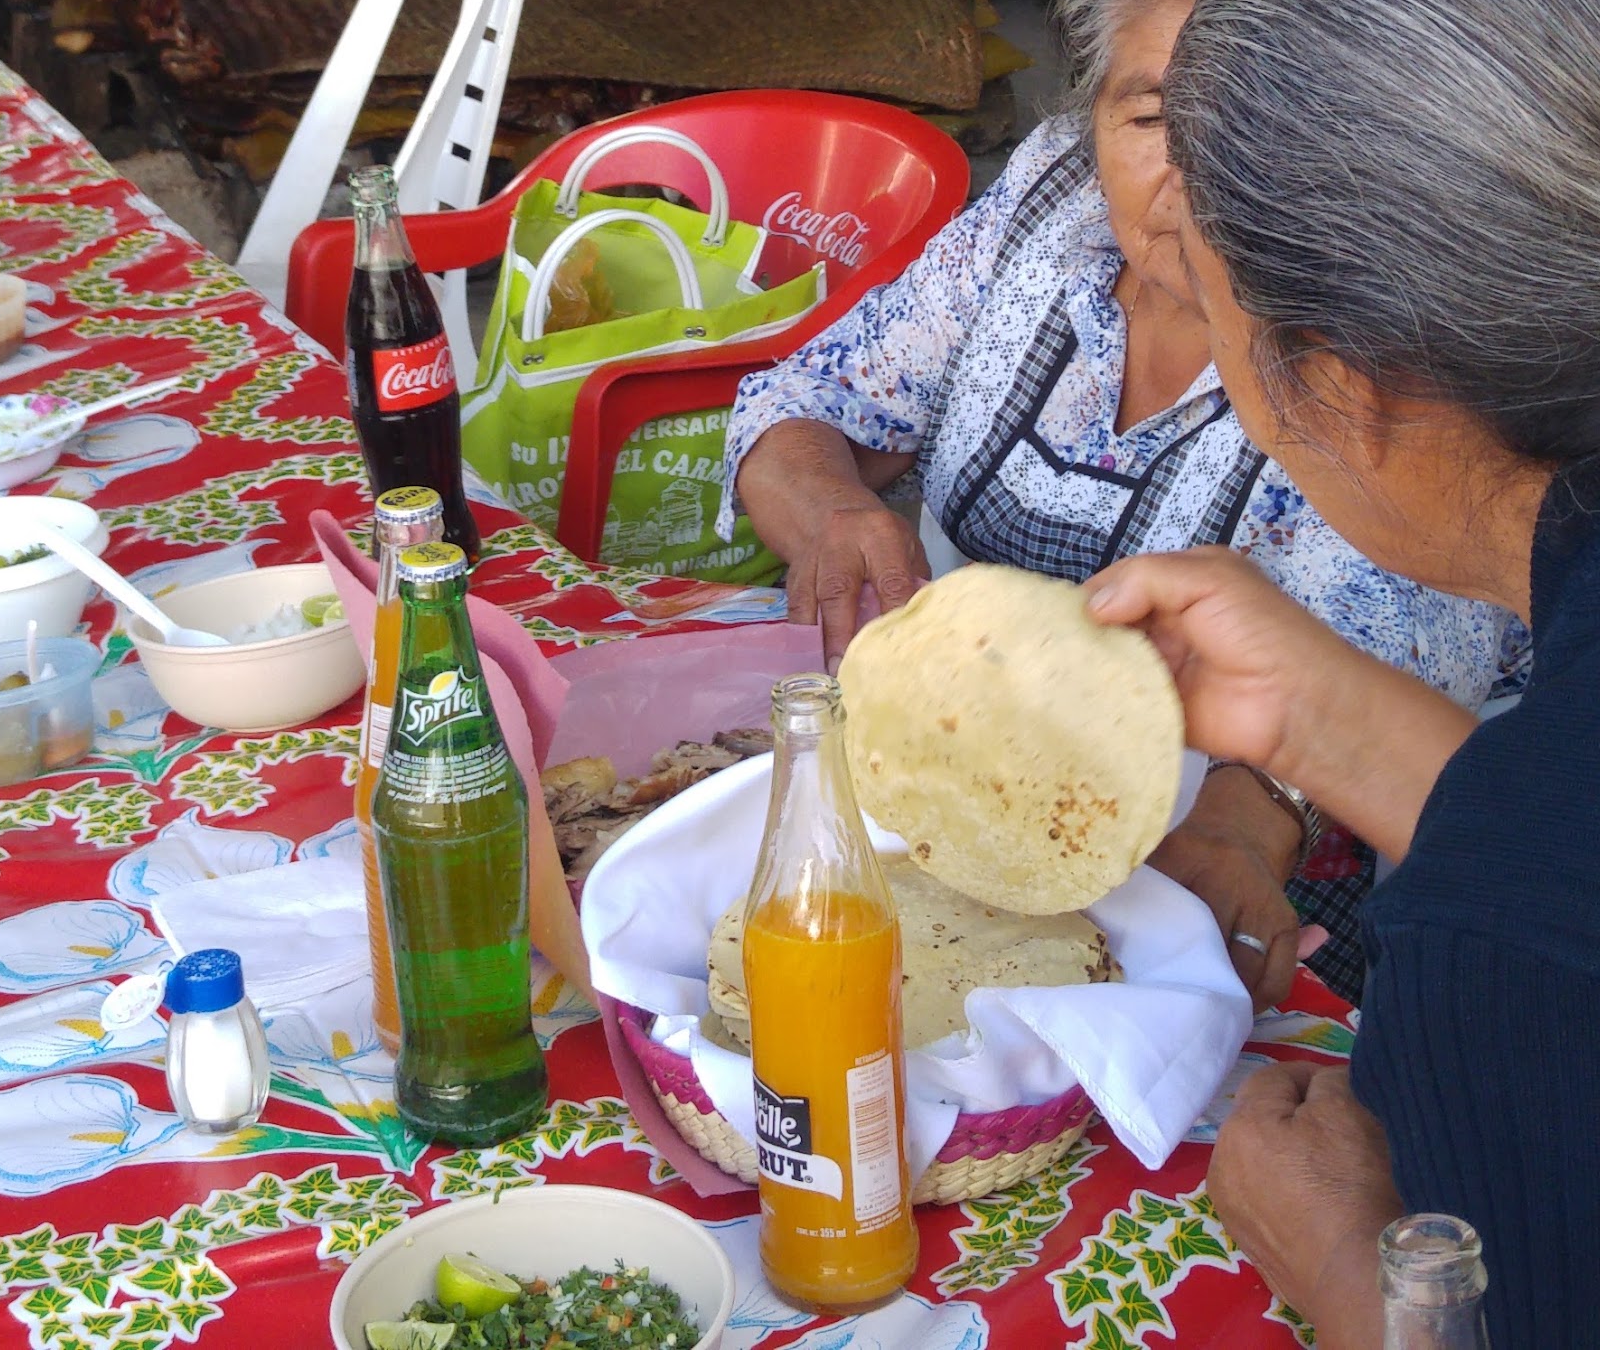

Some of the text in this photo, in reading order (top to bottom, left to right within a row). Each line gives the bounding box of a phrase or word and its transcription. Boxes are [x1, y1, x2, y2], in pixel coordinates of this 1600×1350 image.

[762, 191, 870, 267] Coca-Cola
[630, 411, 729, 443] VERSARI
[615, 449, 646, 474] EL
[653, 449, 726, 486] CARM
[406, 680, 474, 733] Sprite
[757, 1142, 808, 1183] RUT
